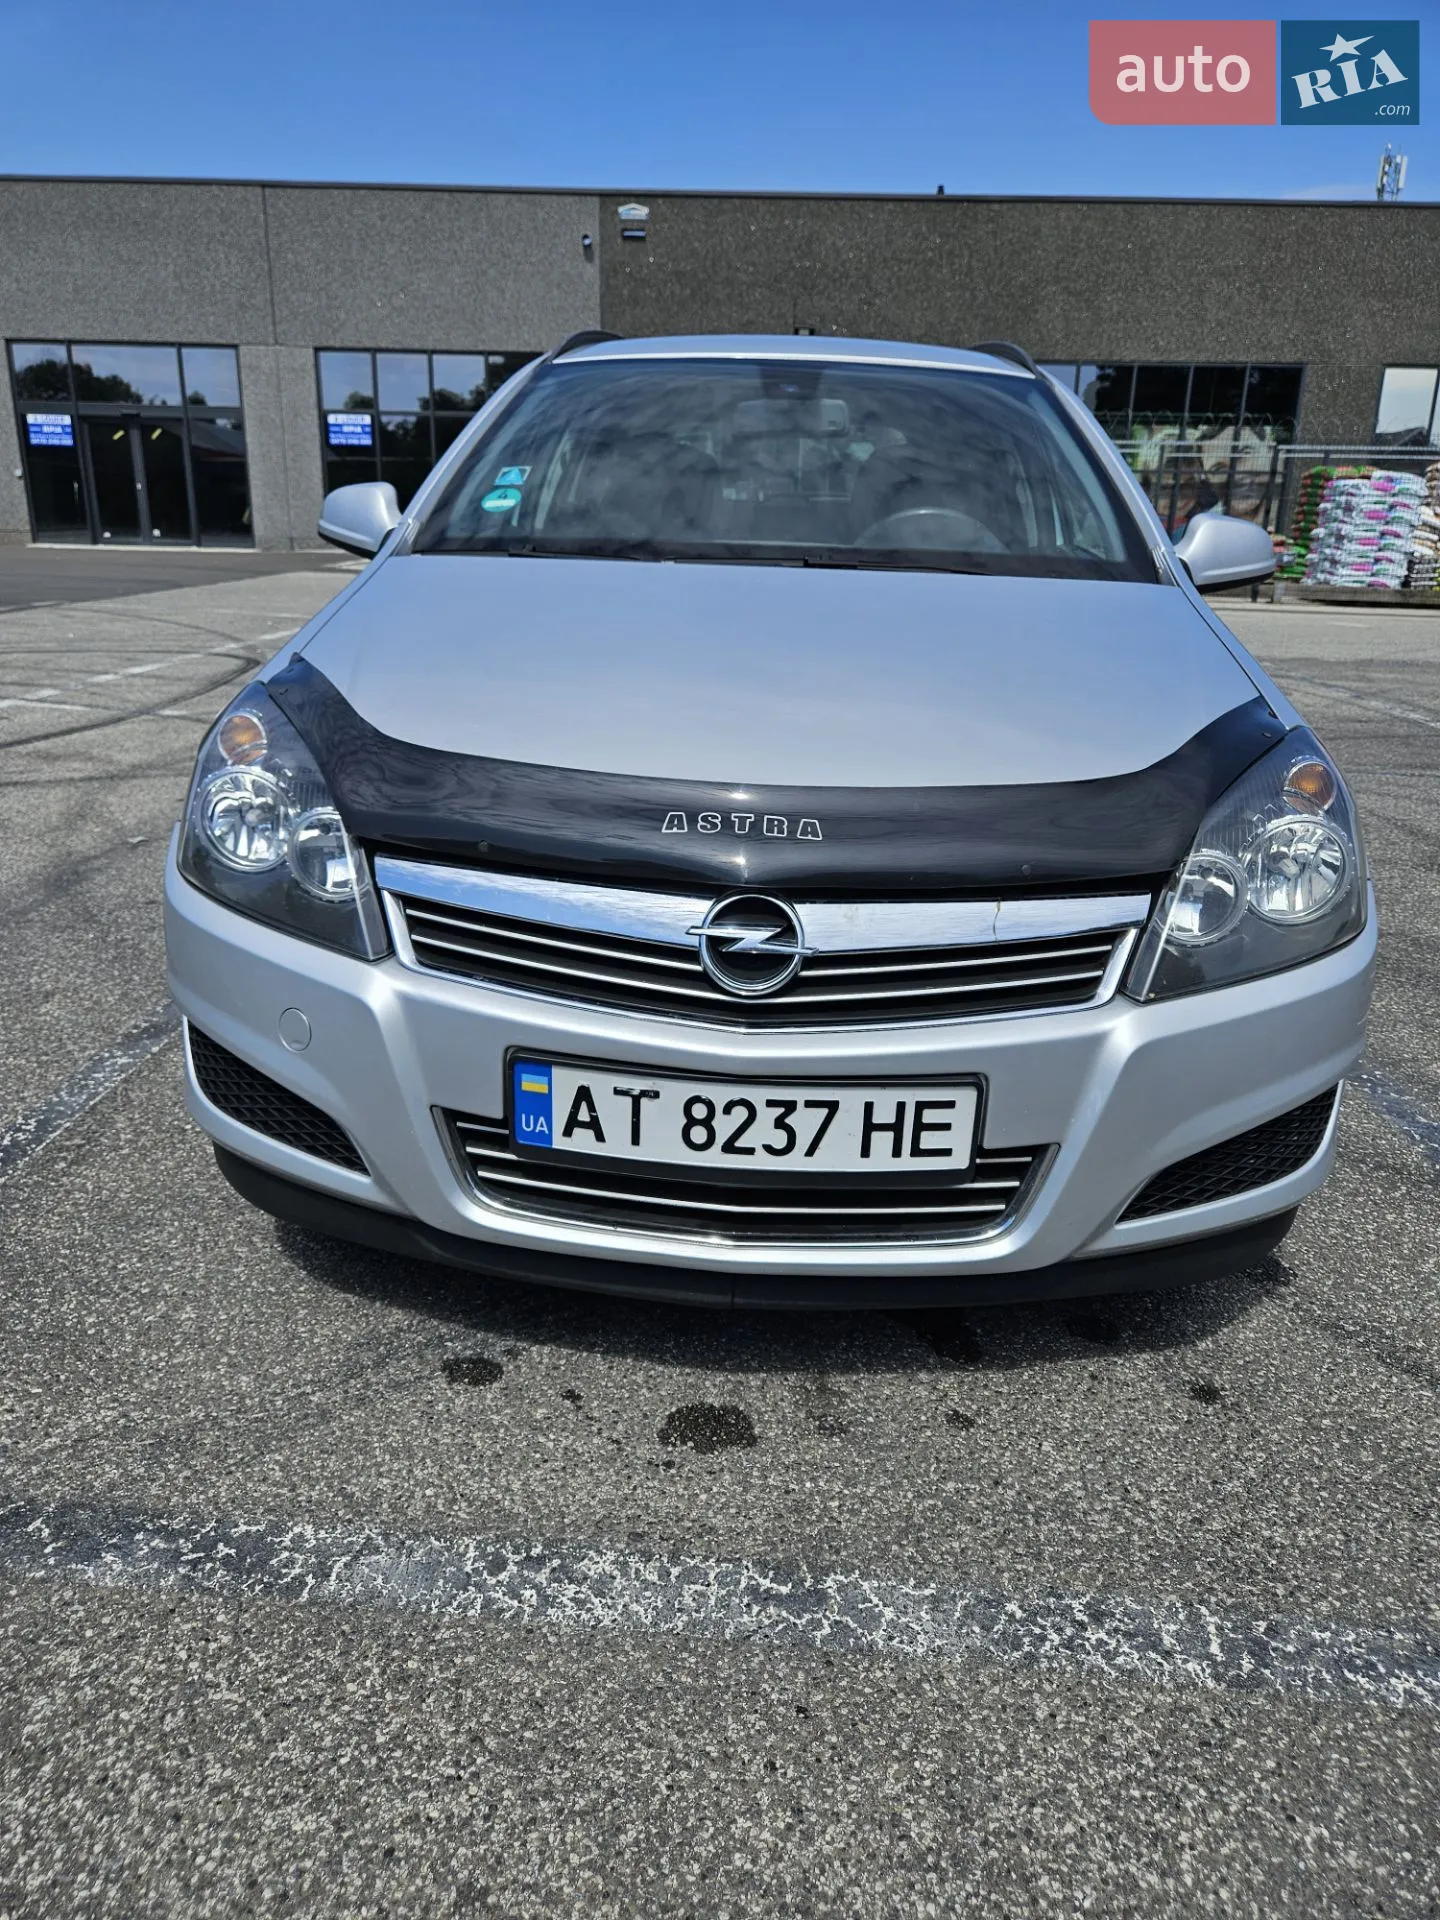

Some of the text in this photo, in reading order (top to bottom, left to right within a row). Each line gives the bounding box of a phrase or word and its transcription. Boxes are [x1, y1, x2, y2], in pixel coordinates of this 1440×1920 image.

[661, 812, 823, 840] ASTRA
[521, 1113, 549, 1134] UA
[562, 1082, 957, 1159] AT 8237 HE
